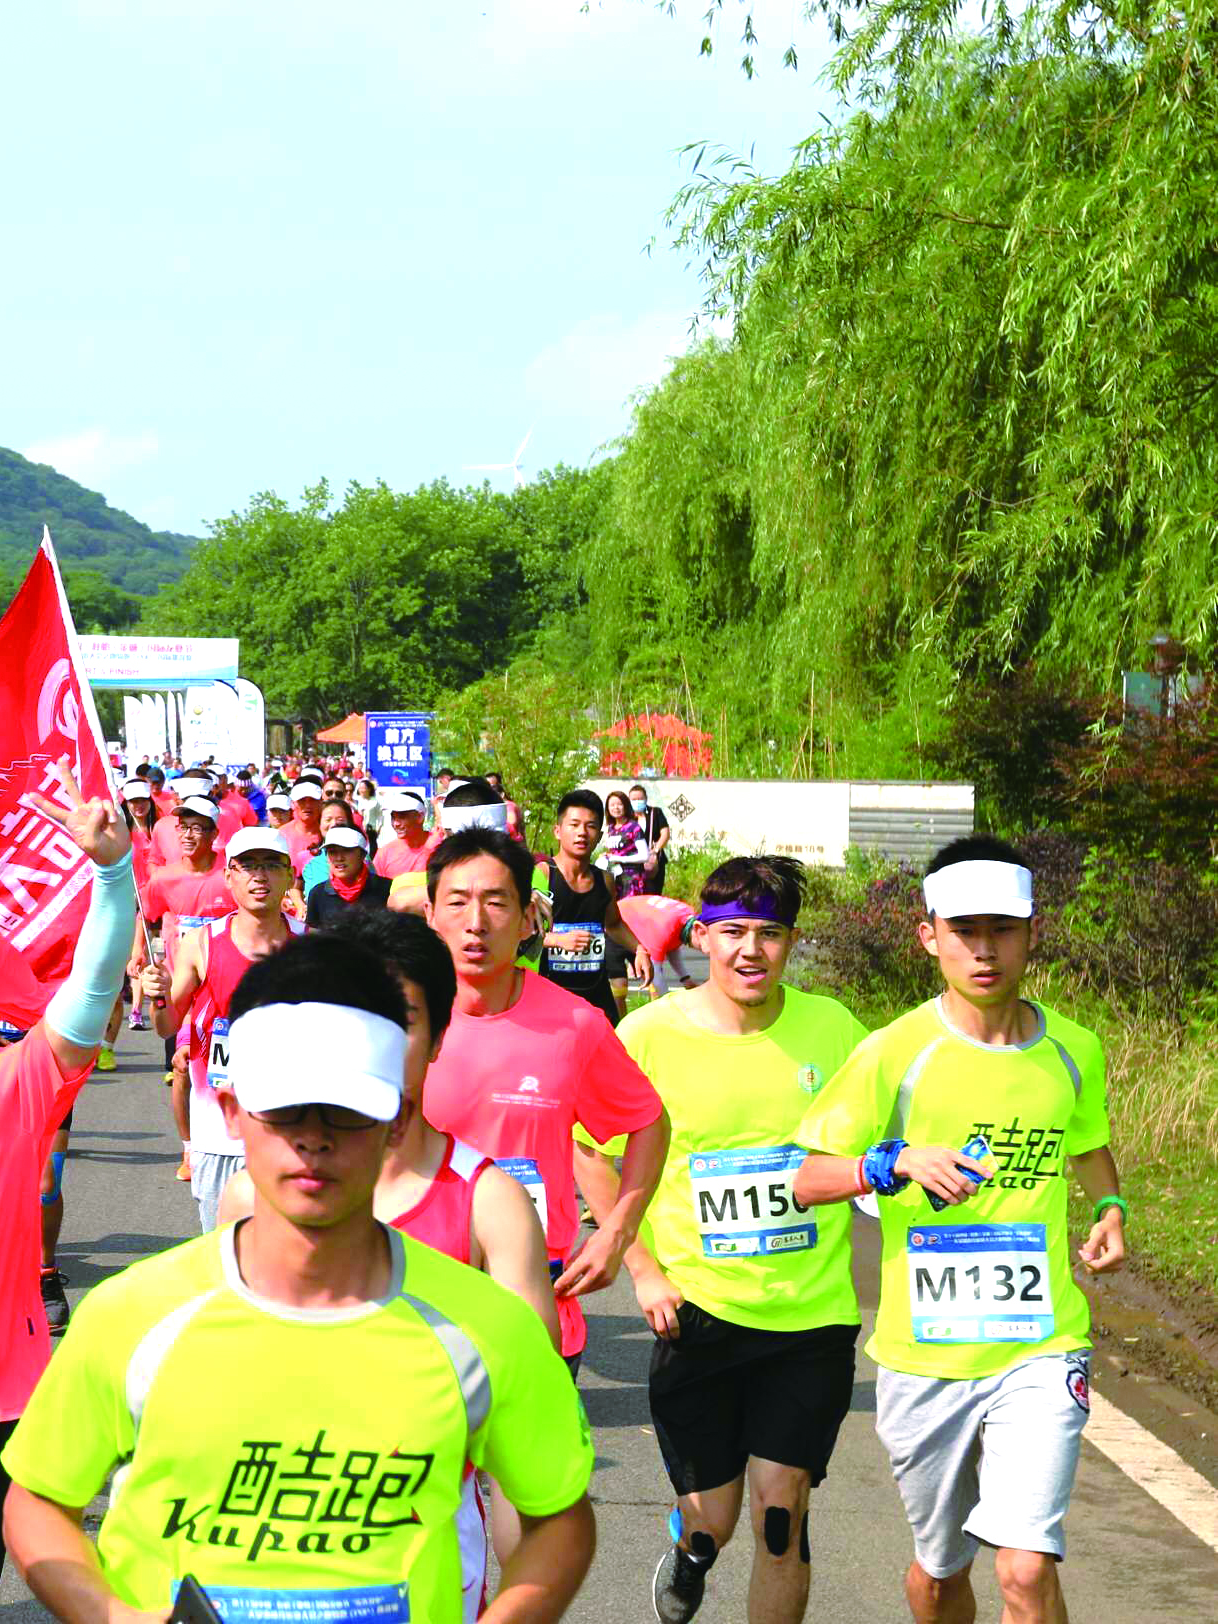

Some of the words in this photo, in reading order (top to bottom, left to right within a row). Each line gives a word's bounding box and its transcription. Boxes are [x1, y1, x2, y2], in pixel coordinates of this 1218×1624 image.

[915, 1264, 1044, 1303] M132
[218, 1430, 435, 1528] 酷跑
[162, 1498, 392, 1562] Kupao
